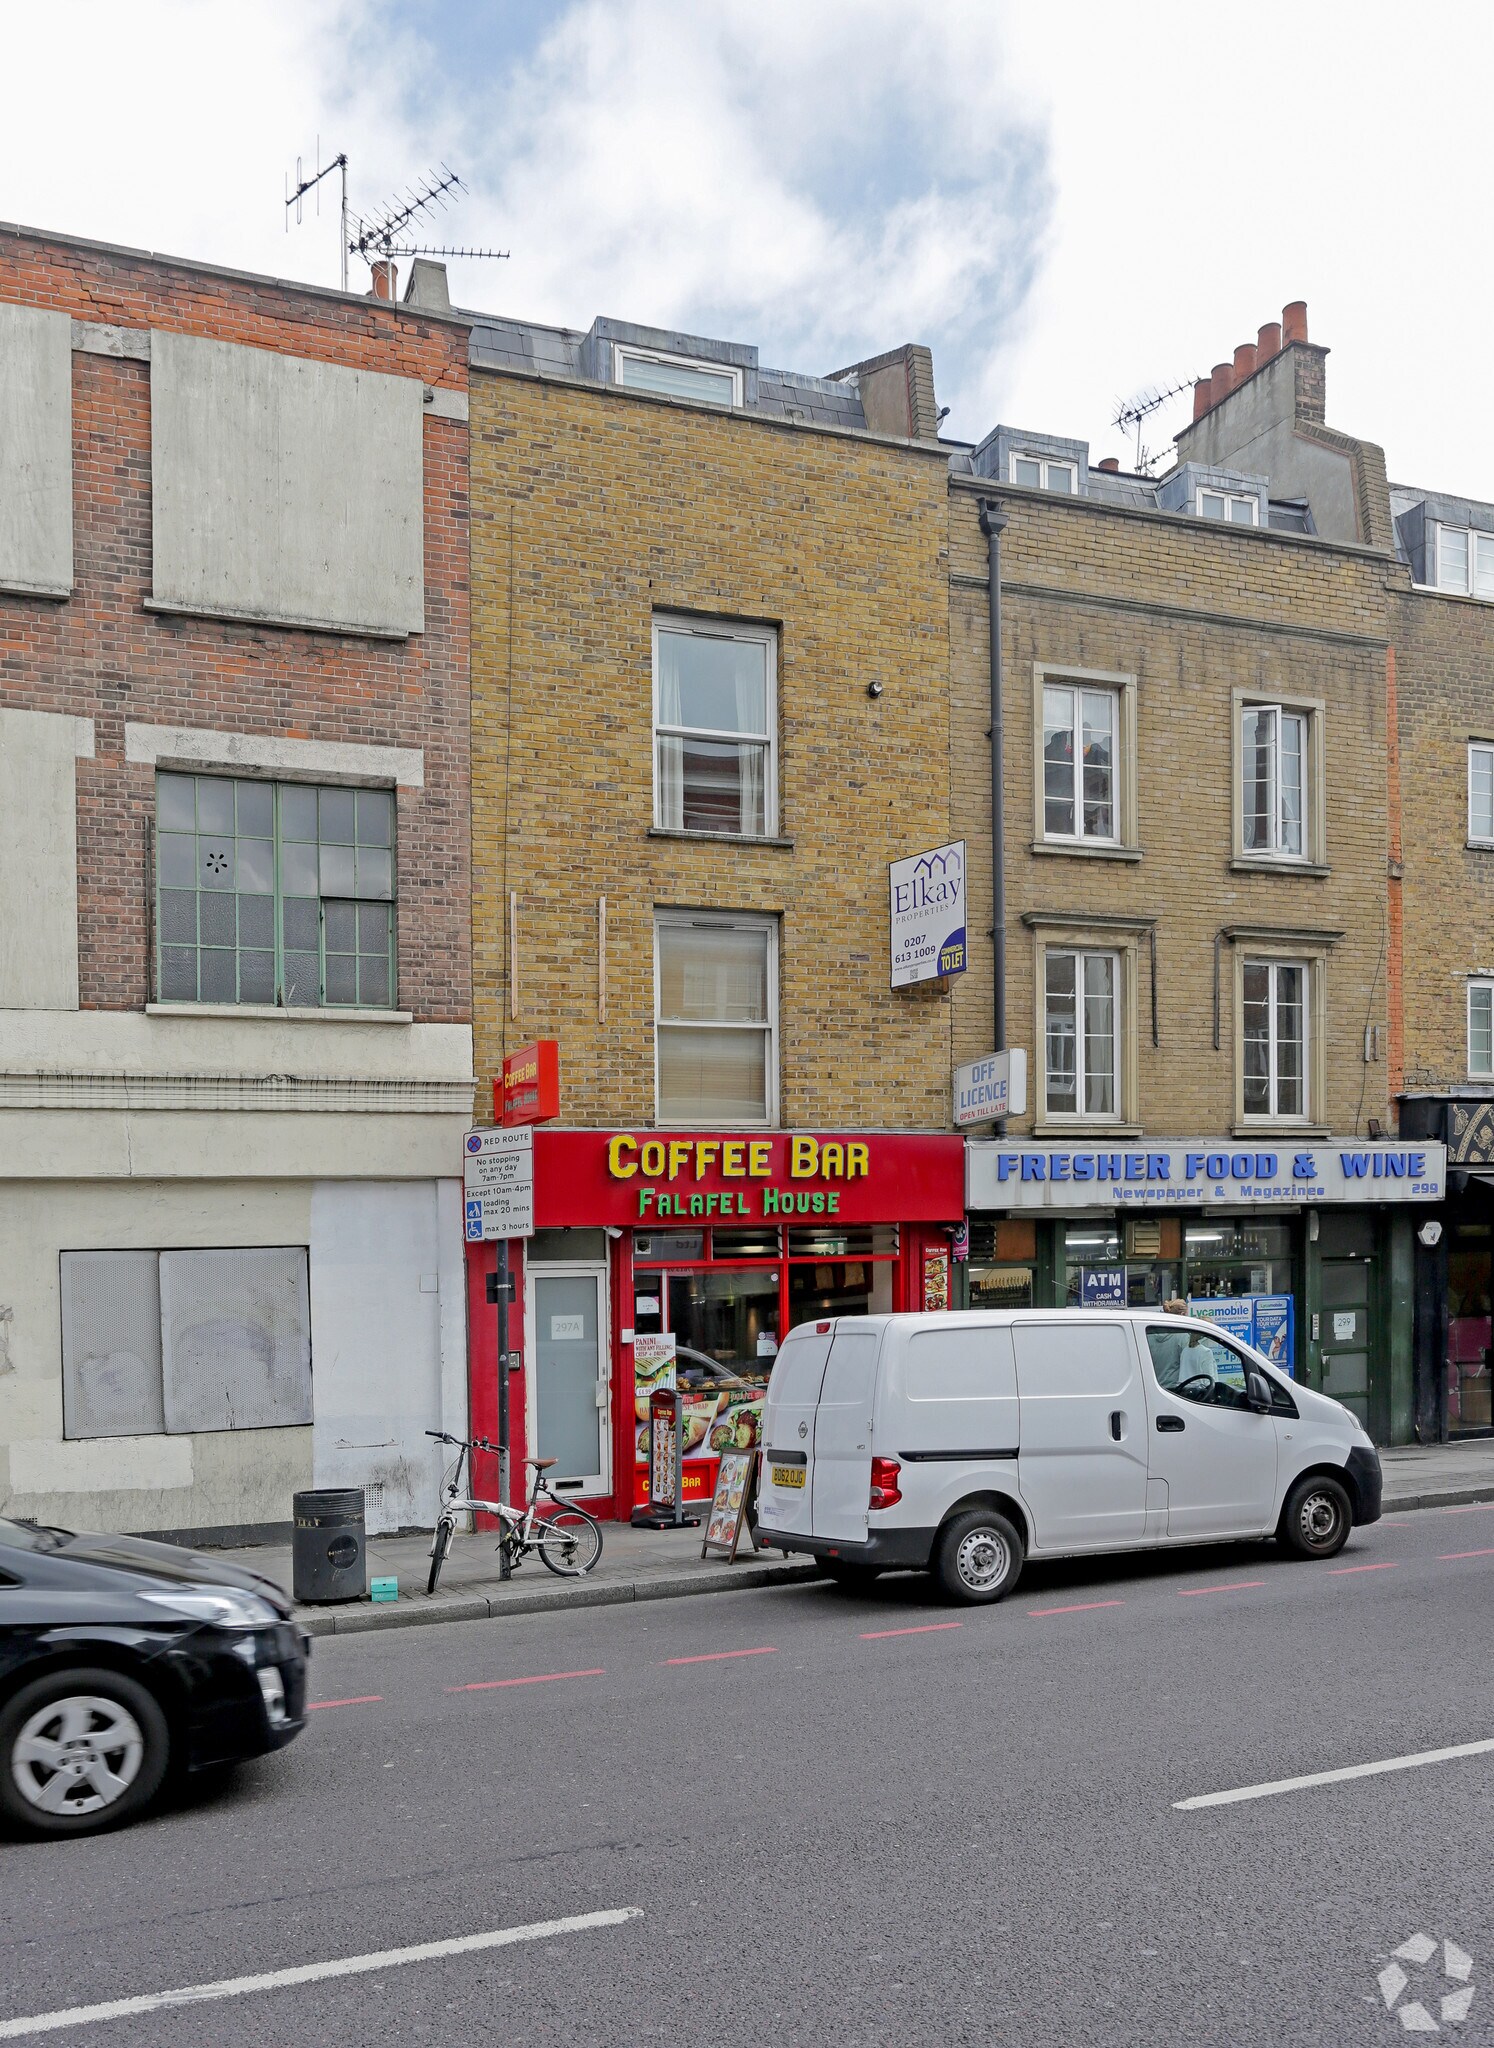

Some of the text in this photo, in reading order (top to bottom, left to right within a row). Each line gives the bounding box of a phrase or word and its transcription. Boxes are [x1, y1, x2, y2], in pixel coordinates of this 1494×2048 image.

[894, 876, 962, 914] Elkay
[896, 903, 949, 924] PROPERTIES
[904, 934, 926, 948] 0207
[895, 946, 936, 964] 613 1009
[941, 951, 964, 971] TO LET
[972, 1061, 994, 1084] OFF
[960, 1080, 1006, 1108] LICENCE
[960, 1102, 1006, 1120] OPEN TILL LATE
[502, 1133, 529, 1143] ROUTE
[489, 1155, 520, 1165] stopping
[608, 1134, 870, 1180] COFFEE BAR
[504, 1164, 517, 1172] day
[998, 1152, 1426, 1182] FRESHER FOOD & WINE
[482, 1173, 514, 1182] 7am-7pm
[467, 1185, 531, 1198] Except 10am-4pm
[1112, 1183, 1438, 1200] Newspaper & Magazines 299
[484, 1199, 509, 1208] loading
[638, 1187, 840, 1217] FALAFEL HOUSE
[509, 1222, 529, 1230] hours
[1087, 1274, 1120, 1286] ATM
[1190, 1305, 1249, 1318] Lycamobile
[556, 1322, 579, 1332] 297A
[1338, 1318, 1351, 1326] 299
[682, 1477, 700, 1488] BAR
